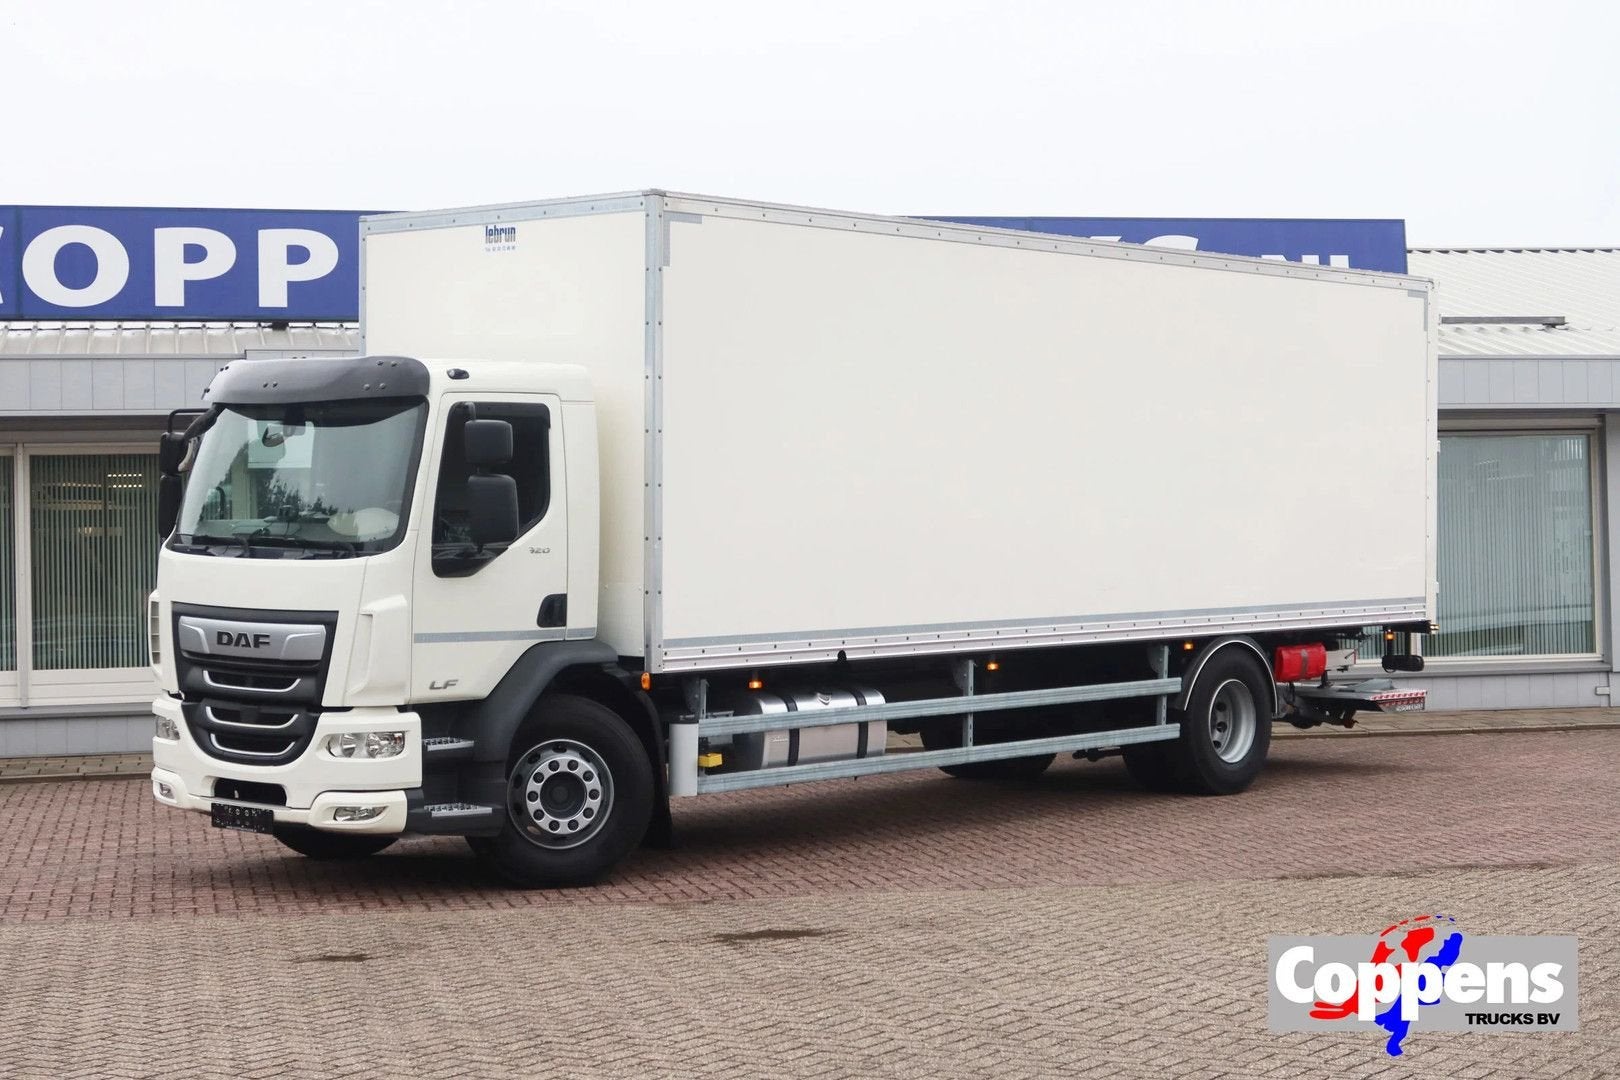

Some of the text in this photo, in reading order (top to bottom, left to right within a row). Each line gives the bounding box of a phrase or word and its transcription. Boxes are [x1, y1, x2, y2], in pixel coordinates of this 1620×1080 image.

[485, 225, 516, 243] lebrun
[0, 225, 339, 308] OPP
[217, 631, 271, 648] DAF
[429, 679, 459, 690] LF
